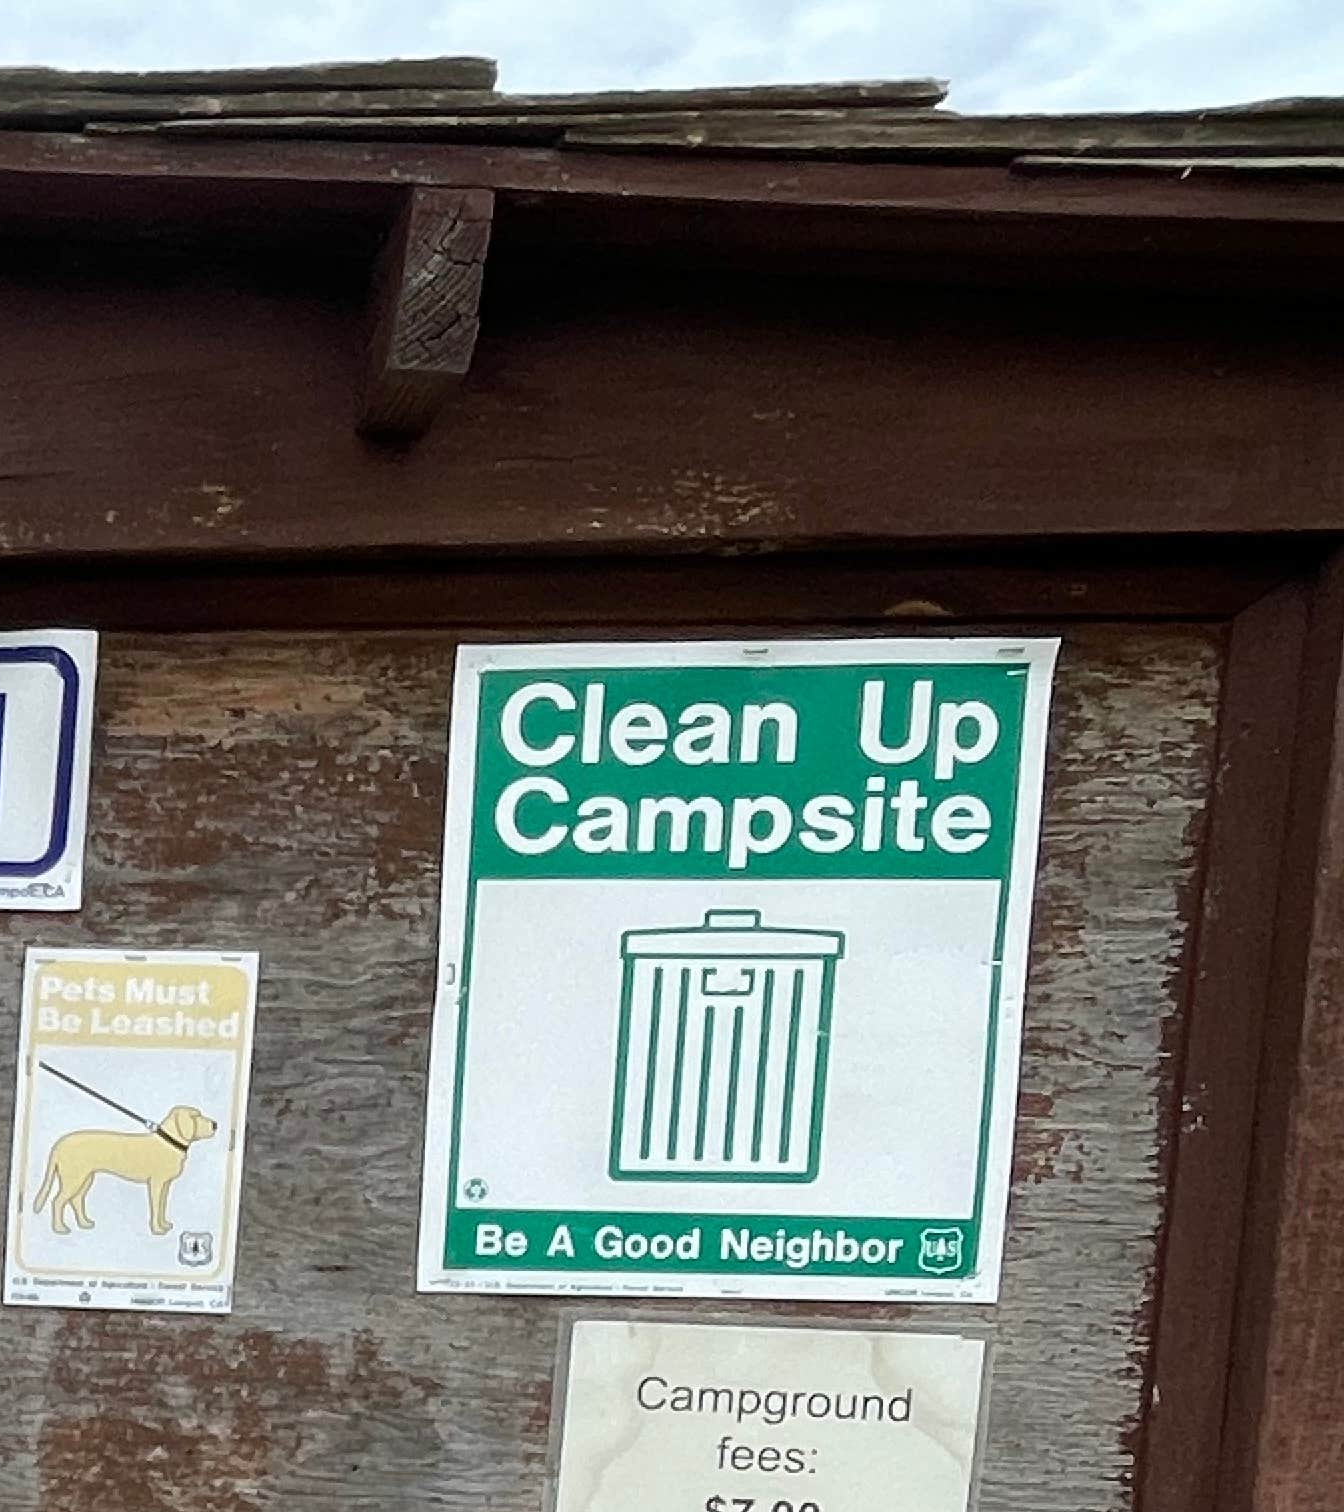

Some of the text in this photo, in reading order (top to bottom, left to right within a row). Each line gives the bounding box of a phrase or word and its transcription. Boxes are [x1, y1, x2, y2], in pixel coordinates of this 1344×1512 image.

[500, 680, 1000, 780] Clean Up
[495, 776, 991, 870] Campsite
[40, 976, 211, 1006] Pets Must
[38, 1006, 240, 1039] Be Leashed
[475, 1224, 904, 1268] Be A Good Neighbor
[636, 1376, 912, 1424] Campground
[717, 1435, 817, 1475] fees:
